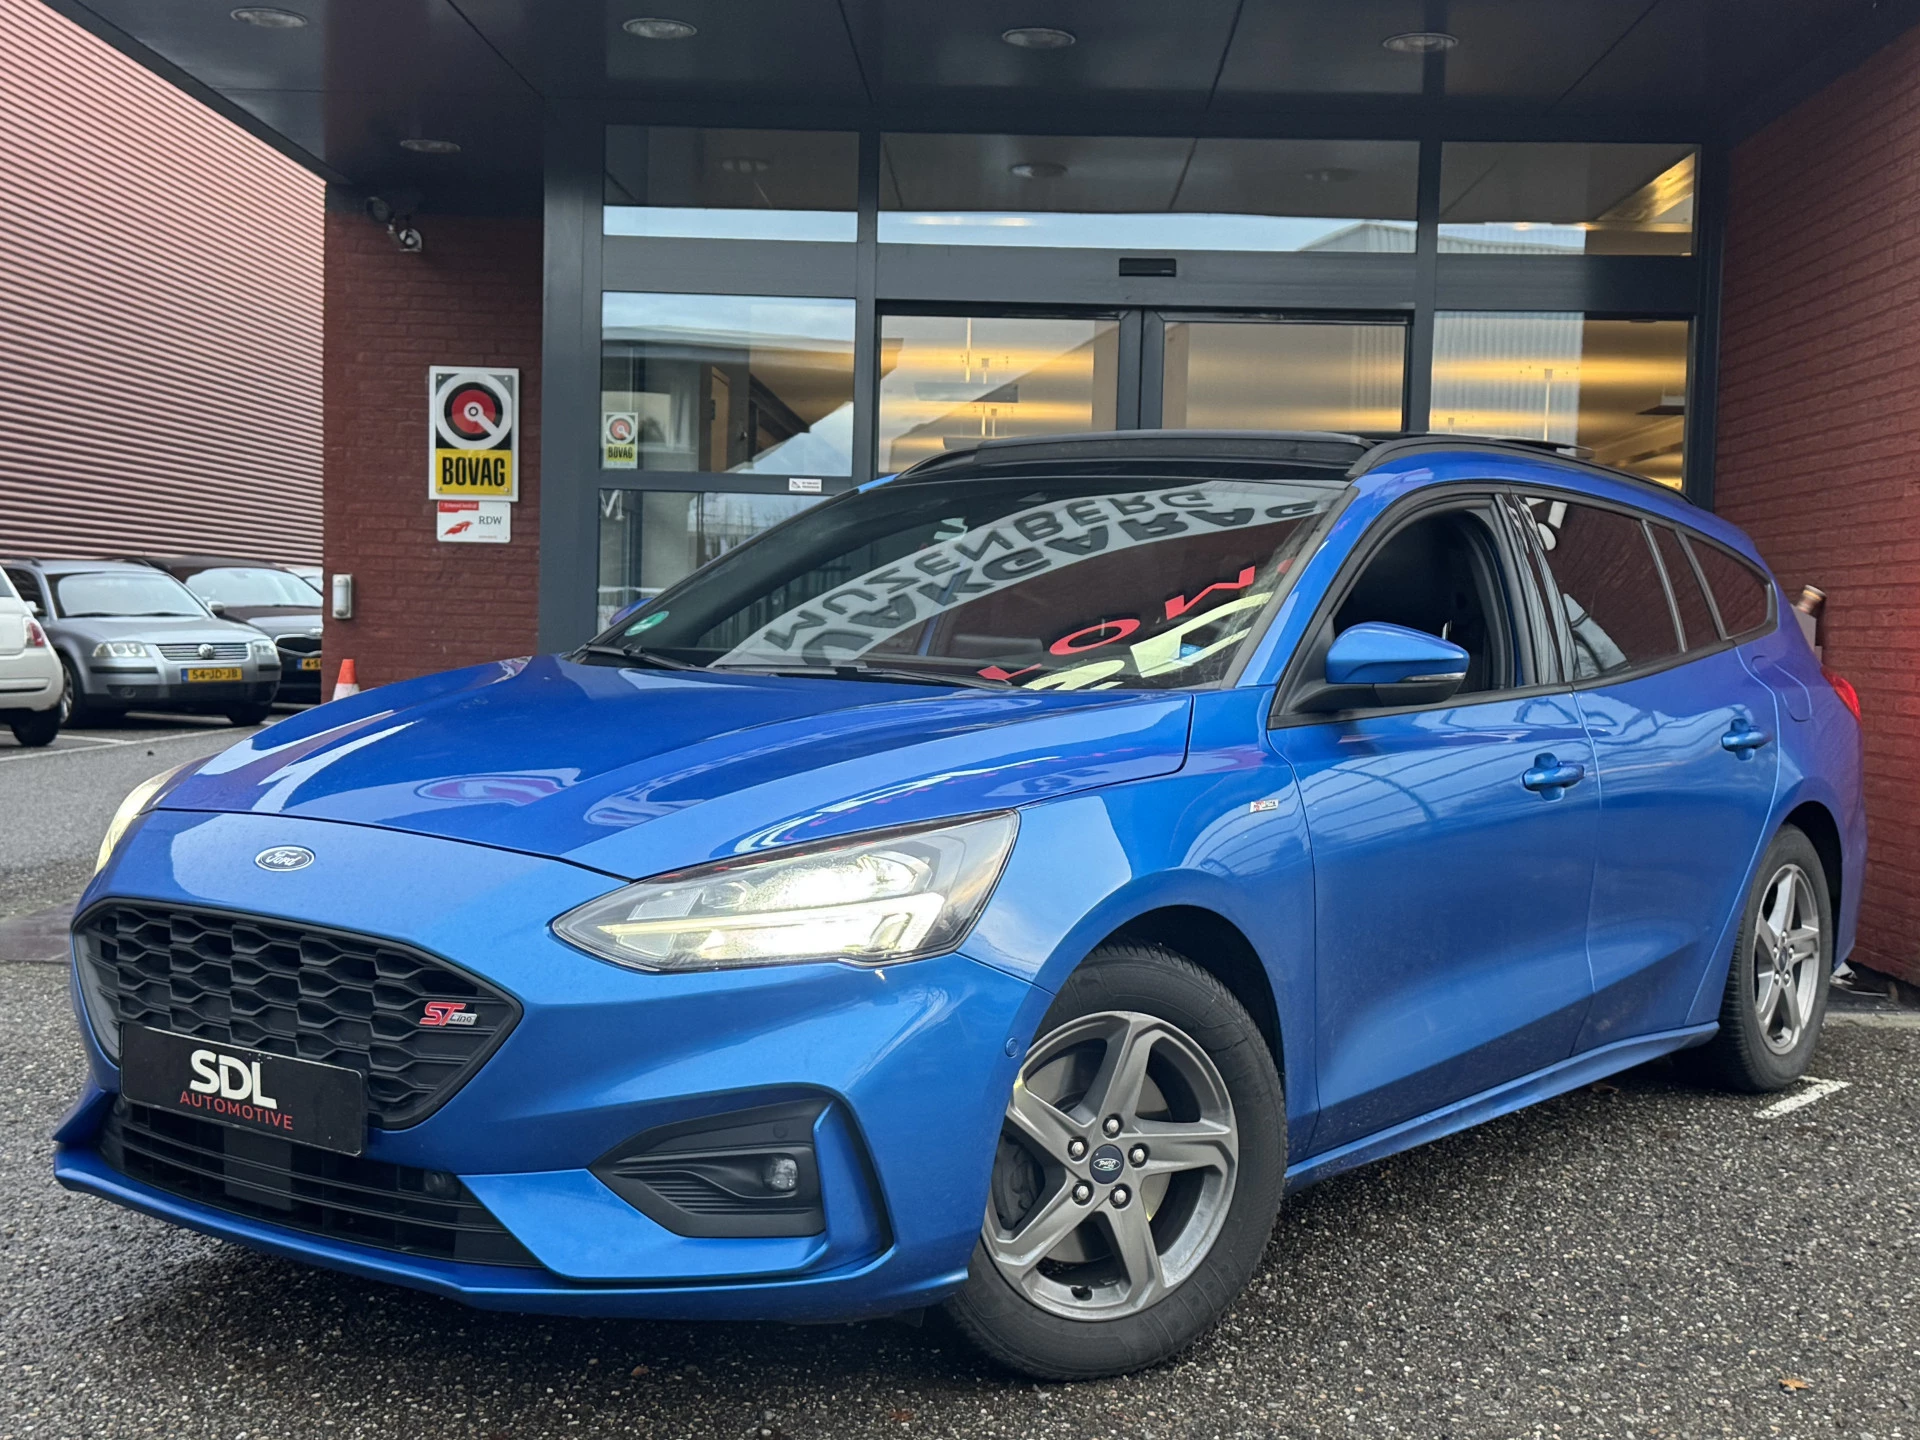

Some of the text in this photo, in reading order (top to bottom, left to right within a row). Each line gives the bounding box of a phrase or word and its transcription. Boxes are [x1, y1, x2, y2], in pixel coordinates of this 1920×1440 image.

[608, 446, 633, 459] BOVAG
[442, 456, 505, 487] BOVAG
[478, 515, 502, 525] RDW
[265, 850, 302, 866] Ford
[419, 1001, 467, 1026] ST
[189, 1049, 277, 1109] SDL
[180, 1090, 294, 1131] AUTOMOTIVE
